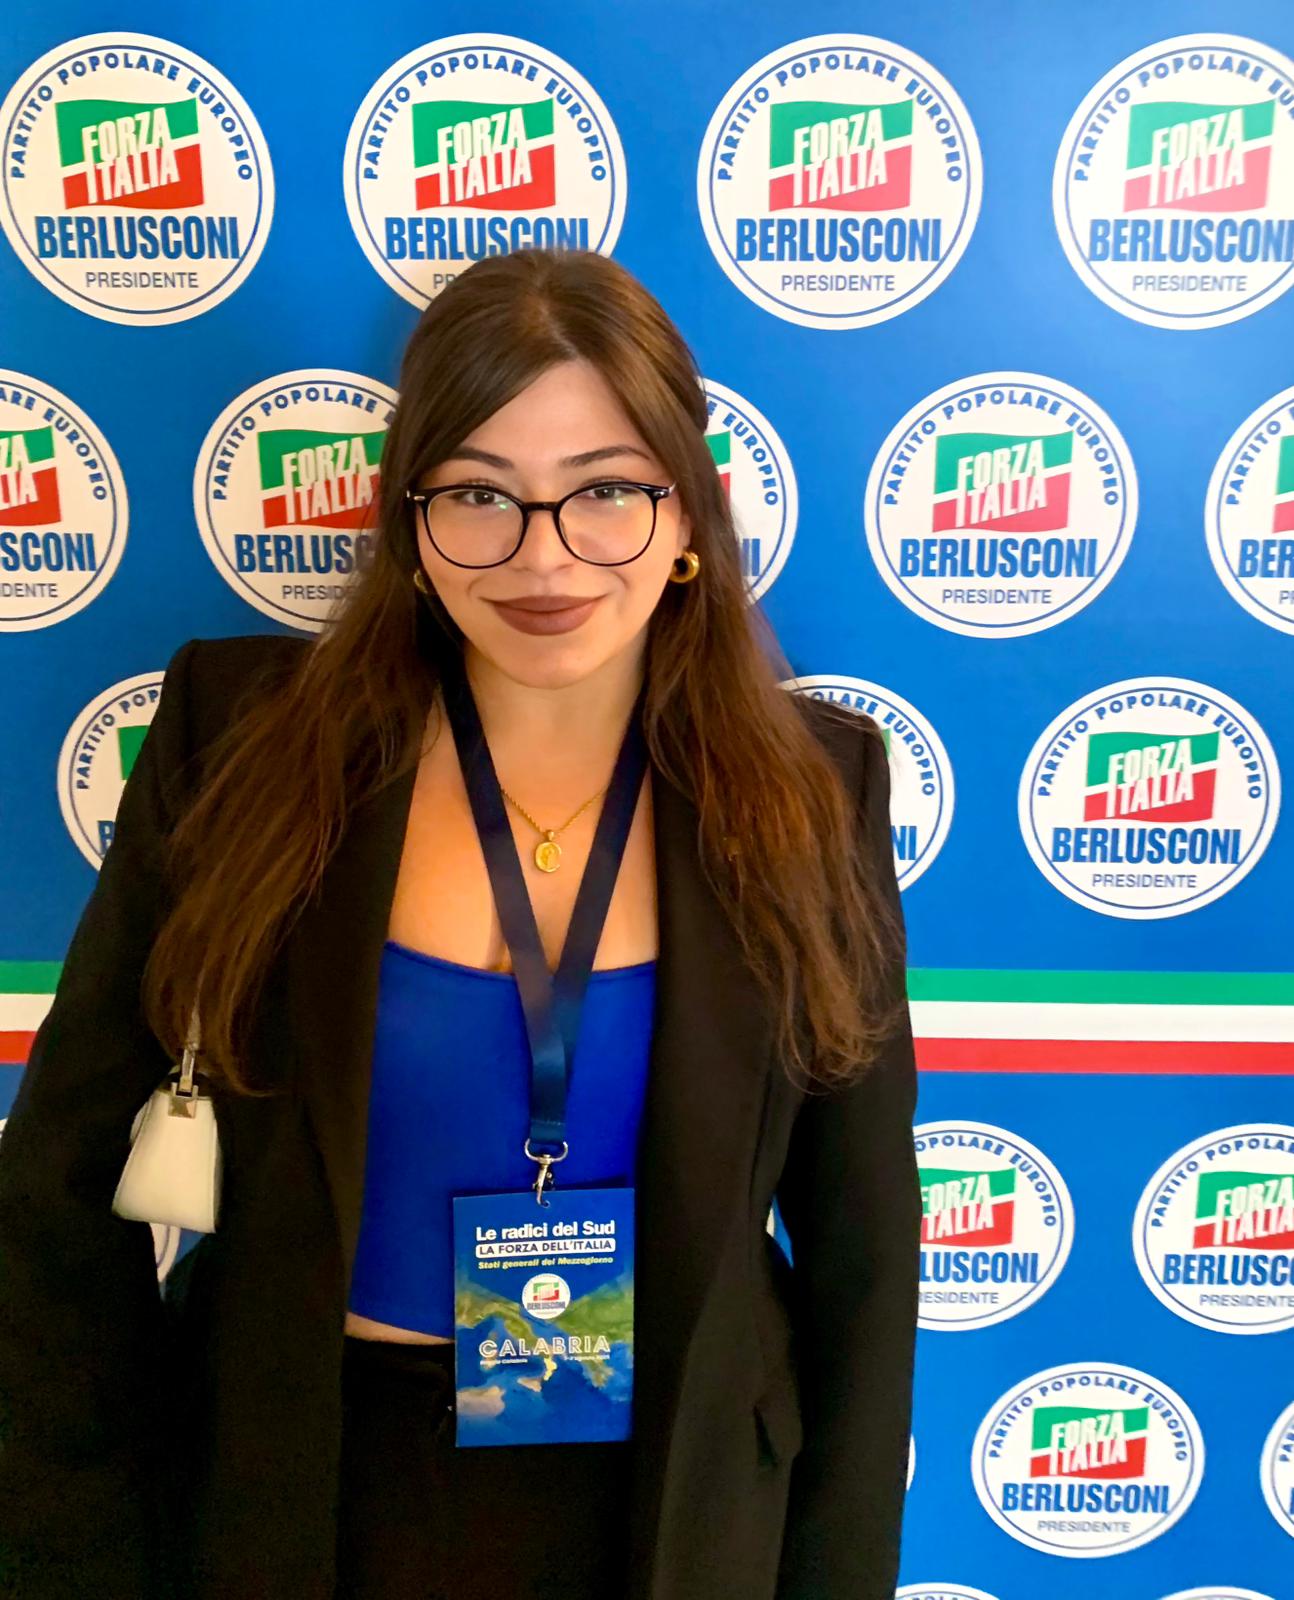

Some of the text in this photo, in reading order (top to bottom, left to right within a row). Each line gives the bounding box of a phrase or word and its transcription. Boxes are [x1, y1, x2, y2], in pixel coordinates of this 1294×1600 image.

[10, 52, 252, 181] PARTITO POPOLARE EUROPEO
[82, 107, 171, 158] FORZA
[363, 53, 606, 182] PARTITO POPOLARE EUROPEO
[437, 107, 527, 159] FORZA
[718, 53, 962, 183] PARTITO POPOLARE EUROPEO
[793, 108, 885, 160] FORZA
[1073, 53, 1264, 182] PARTITO POPOLARE
[1151, 108, 1244, 160] FORZA
[86, 143, 179, 205] ITALIA
[440, 144, 533, 206] ITALIA
[793, 145, 888, 206] ITALIA
[1149, 145, 1246, 207] ITALIA
[36, 215, 240, 261] BERLUSCONI
[735, 217, 941, 262] BERLUSCONI
[86, 272, 199, 289] PRESIDENTE
[781, 274, 895, 291] PRESIDENTE
[1131, 274, 1247, 291] PRESIDENTE
[43, 408, 107, 500] EUROPEO
[213, 387, 378, 500] PARTITO POPOLARE
[282, 437, 367, 486] FORZA
[722, 413, 778, 506] EUROPEO
[884, 389, 1119, 506] PARTITO POPOLARE EUROPEO
[957, 439, 1044, 490] FORZA
[1225, 420, 1281, 505] PARTITO
[284, 472, 373, 523] ITALIA
[955, 475, 1047, 527] ITALIA
[0, 532, 97, 571] SCONI
[234, 534, 376, 574] BERLUSC
[900, 538, 1097, 578] BERLUSCONI
[0, 583, 58, 597] DENTE
[942, 589, 1052, 604] PRESIDENTE
[76, 713, 115, 789] PARTITO
[811, 691, 935, 796] OLARE EUROPEO
[1037, 693, 1262, 799] PARTITO POPOLARE EUROPEO
[1108, 738, 1193, 785] FORZA
[1106, 769, 1194, 818] ITALIA
[1051, 827, 1241, 864] BERLUSCONI
[1092, 874, 1197, 888] PRESIDENTE
[914, 1135, 1056, 1227] OPOLARE EUROPEO
[1151, 1160, 1199, 1227] PARTITO
[1216, 1176, 1294, 1217] FORZA
[475, 1219, 615, 1241] Le radici del Sud
[923, 1202, 994, 1241] TALIA
[479, 1240, 612, 1255] LA FORZA DELL'ITALIA
[502, 1258, 540, 1270] generali
[919, 1251, 1038, 1283] LUSCONI
[1163, 1254, 1294, 1286] BERLUSC
[478, 1335, 611, 1358] CALABRIA
[989, 1375, 1188, 1462] PARTITO POPOLARE EUROPEO
[1050, 1411, 1127, 1451] FORZA
[1048, 1438, 1128, 1475] ITALIA
[1002, 1483, 1169, 1514] BERLUSCONI
[1037, 1520, 1131, 1533] PRESIDENTE
